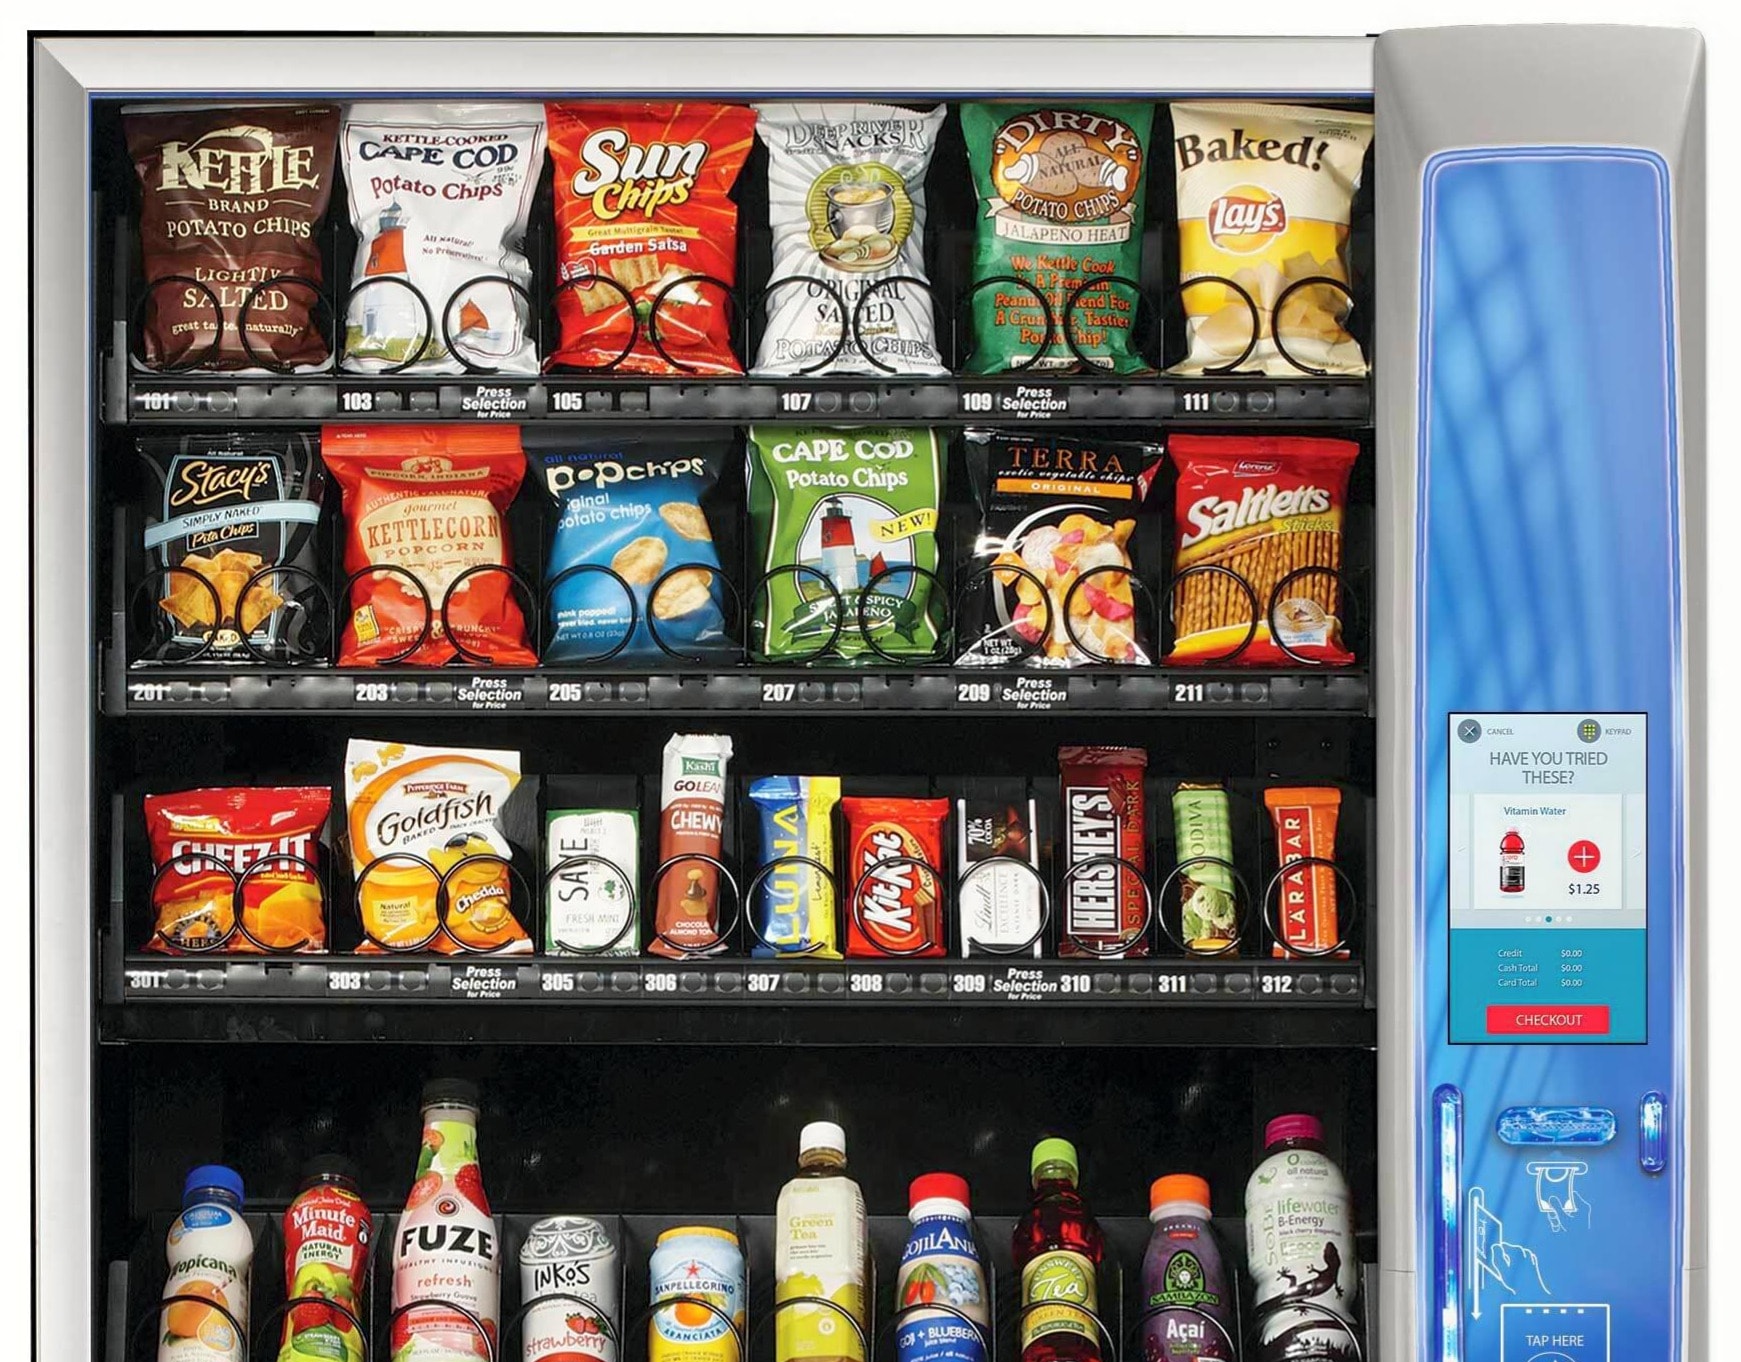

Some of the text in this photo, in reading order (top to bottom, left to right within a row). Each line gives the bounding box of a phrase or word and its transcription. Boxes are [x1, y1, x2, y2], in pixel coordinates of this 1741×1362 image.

[997, 111, 1138, 153] DIRTY
[359, 141, 518, 169] CAPE COD
[1176, 129, 1329, 172] Baked!
[156, 128, 320, 195] KETTLE
[573, 129, 707, 195] Sun
[371, 175, 503, 200] Potato Chips
[208, 198, 269, 213] BRAND
[592, 176, 694, 220] Chips
[1012, 190, 1119, 219] POTATO CHIPS
[1213, 198, 1283, 236] Lay's
[166, 217, 311, 238] POTATO CHIPS
[1088, 226, 1127, 242] HEAT
[1011, 255, 1115, 273] We Kettle Cook
[475, 385, 512, 398] Press
[142, 393, 171, 410] 101
[342, 392, 372, 411] 103
[459, 396, 527, 410] Selection
[552, 392, 582, 411] 105
[781, 392, 812, 411] 107
[962, 392, 992, 411] 109
[1183, 393, 1209, 411] 111
[489, 410, 512, 418] Price
[772, 439, 914, 463] CAPE COD
[1008, 447, 1123, 472] TERRA
[171, 461, 271, 506] Stacy's
[786, 466, 908, 491] Potato Chips
[1031, 482, 1100, 494] ORIGINAL
[403, 501, 457, 516] gourmet
[183, 507, 260, 529] SIMPLY NAKED
[881, 512, 931, 537] NEW!
[1279, 518, 1334, 533] Sticks
[192, 523, 255, 548] Pita Chips
[367, 515, 498, 549] KETTLECORN
[384, 542, 485, 558] POPCORN
[1016, 677, 1052, 689] Press
[134, 684, 163, 701] 201
[355, 683, 390, 702] 203
[549, 683, 582, 702] 205
[763, 683, 796, 702] 207
[958, 683, 991, 702] 209
[1002, 688, 1067, 701] Selection
[1175, 684, 1203, 702] 211
[1029, 701, 1051, 709] Price
[1487, 727, 1514, 736] CANCEL
[1605, 727, 1632, 736] KEYPAD
[1490, 752, 1608, 766] HAVE YOU TRIED
[1522, 770, 1574, 784] THESE?
[377, 790, 492, 846] Goldfish
[1504, 806, 1566, 816] Vitamin Water
[671, 810, 723, 834] CHEWY
[402, 828, 436, 845] BAKED
[1072, 794, 1115, 929] HERSHEY'S
[1568, 883, 1600, 896] $1.25
[1497, 949, 1583, 959] Credit $0.00
[1497, 963, 1583, 973] Cash Total $0.00
[130, 972, 161, 988] 301
[329, 971, 362, 990] 303
[542, 972, 574, 991] 305
[645, 973, 677, 992] 306
[748, 973, 780, 992] 307
[850, 974, 883, 992] 308
[953, 974, 985, 993] 309
[1060, 974, 1091, 993] 310
[1158, 975, 1186, 993] 311
[1262, 975, 1293, 993] 312
[1497, 978, 1583, 988] Card Total $0.00
[1515, 1014, 1583, 1026] CHECKOUT
[1278, 1198, 1340, 1215] lifewater
[292, 1206, 356, 1229] Minute
[789, 1216, 834, 1228] Green
[1278, 1215, 1325, 1227] B-Energy
[301, 1220, 345, 1241] Maid
[790, 1229, 818, 1240] Tea
[301, 1242, 343, 1255] NATURAL
[401, 1225, 493, 1261] FUZE
[304, 1249, 339, 1260] ENERGY
[418, 1274, 471, 1288] refresh
[655, 1280, 735, 1295] SANPELLEGRINO
[1030, 1274, 1084, 1299] Tea
[1167, 1319, 1205, 1343] Açaí
[526, 1332, 607, 1357] strawberry
[1526, 1335, 1584, 1347] TAP HERE
